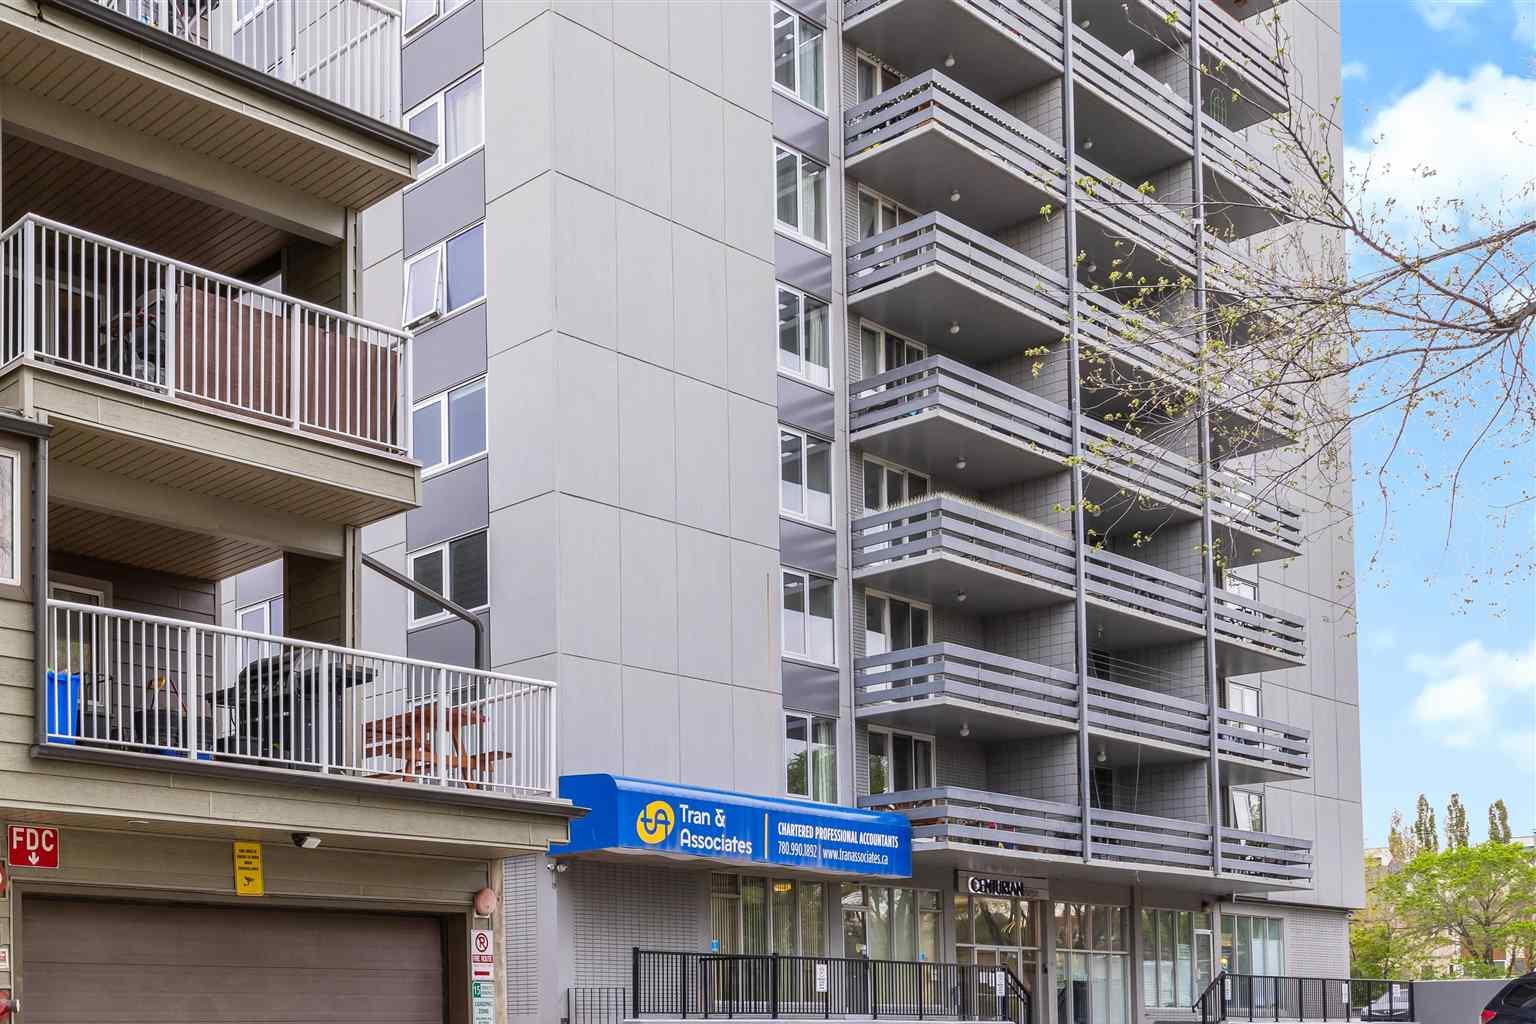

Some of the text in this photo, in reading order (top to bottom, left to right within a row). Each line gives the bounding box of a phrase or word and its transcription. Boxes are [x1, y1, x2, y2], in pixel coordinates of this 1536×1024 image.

[679, 804, 726, 828] Tran &
[12, 827, 55, 852] FDC
[680, 828, 753, 855] Associates
[777, 822, 899, 849] CHARTERED PROFESSIONAL ACCOUNTANTS
[777, 840, 889, 865] 780.990.1892 www.tranassociates.ca
